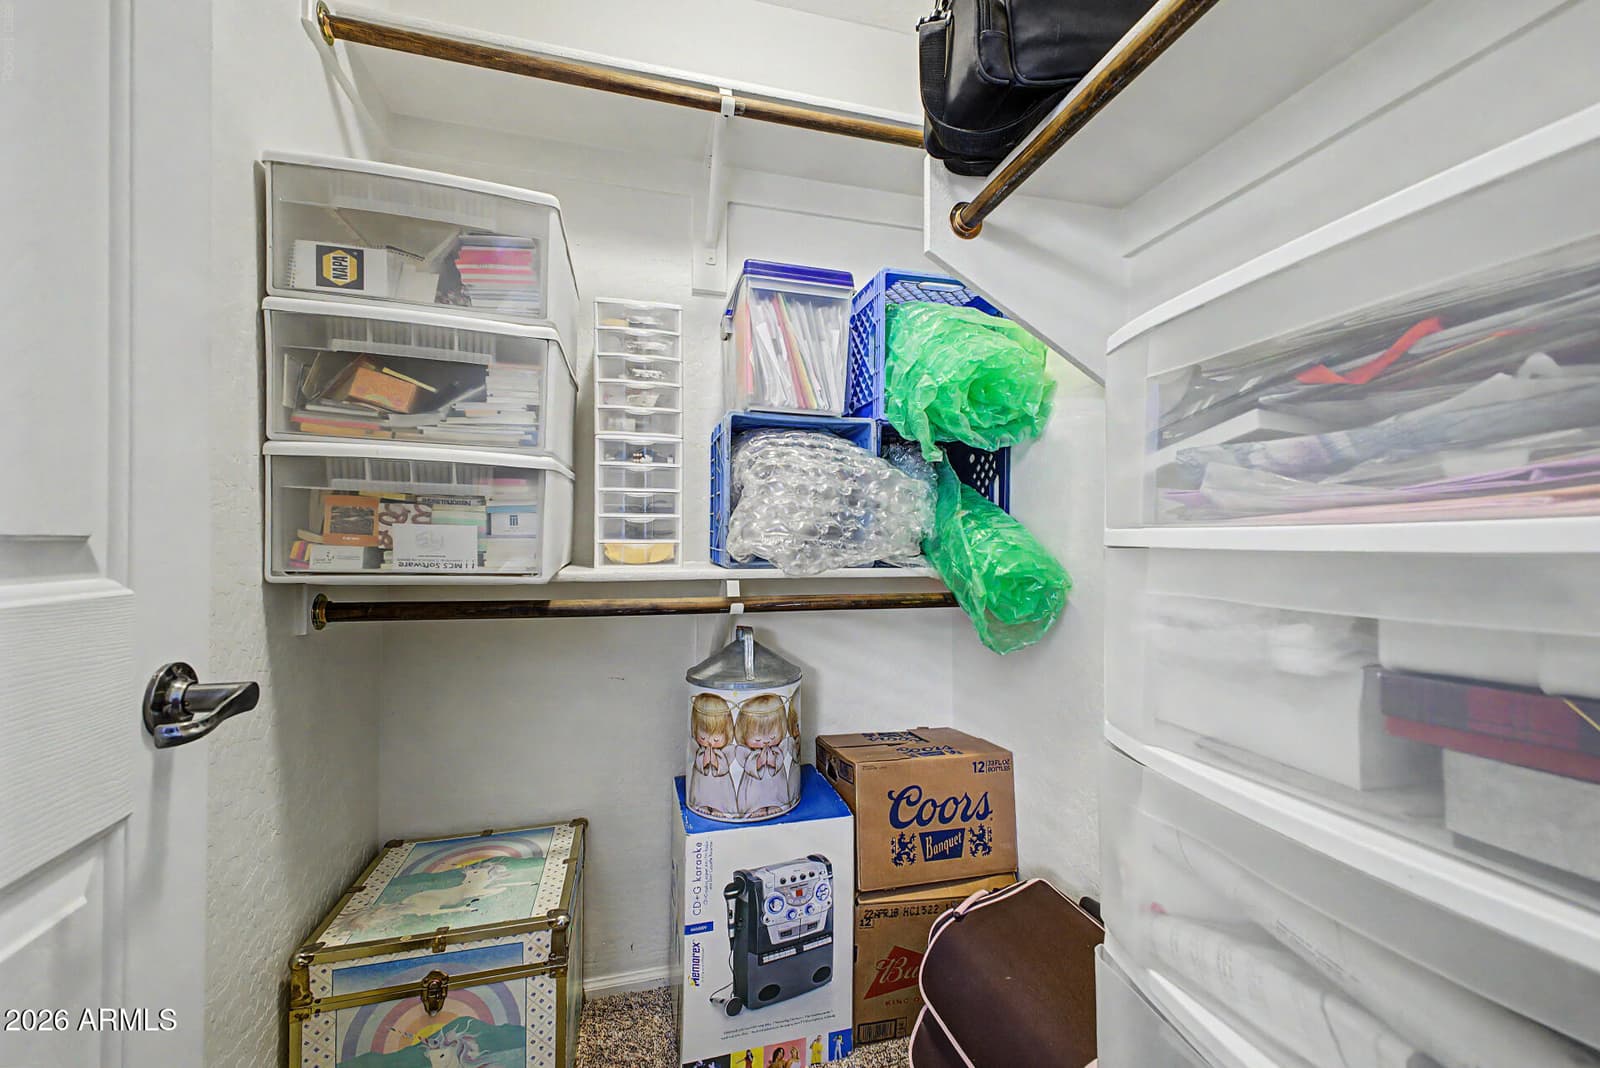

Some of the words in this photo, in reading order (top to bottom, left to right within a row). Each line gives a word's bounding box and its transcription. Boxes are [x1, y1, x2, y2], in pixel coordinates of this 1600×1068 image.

[332, 255, 348, 281] NAPA
[972, 761, 985, 773] 12
[888, 785, 993, 829] Coors
[925, 832, 963, 858] Banquet
[692, 842, 702, 882] karaoke
[689, 942, 701, 987] Memorex
